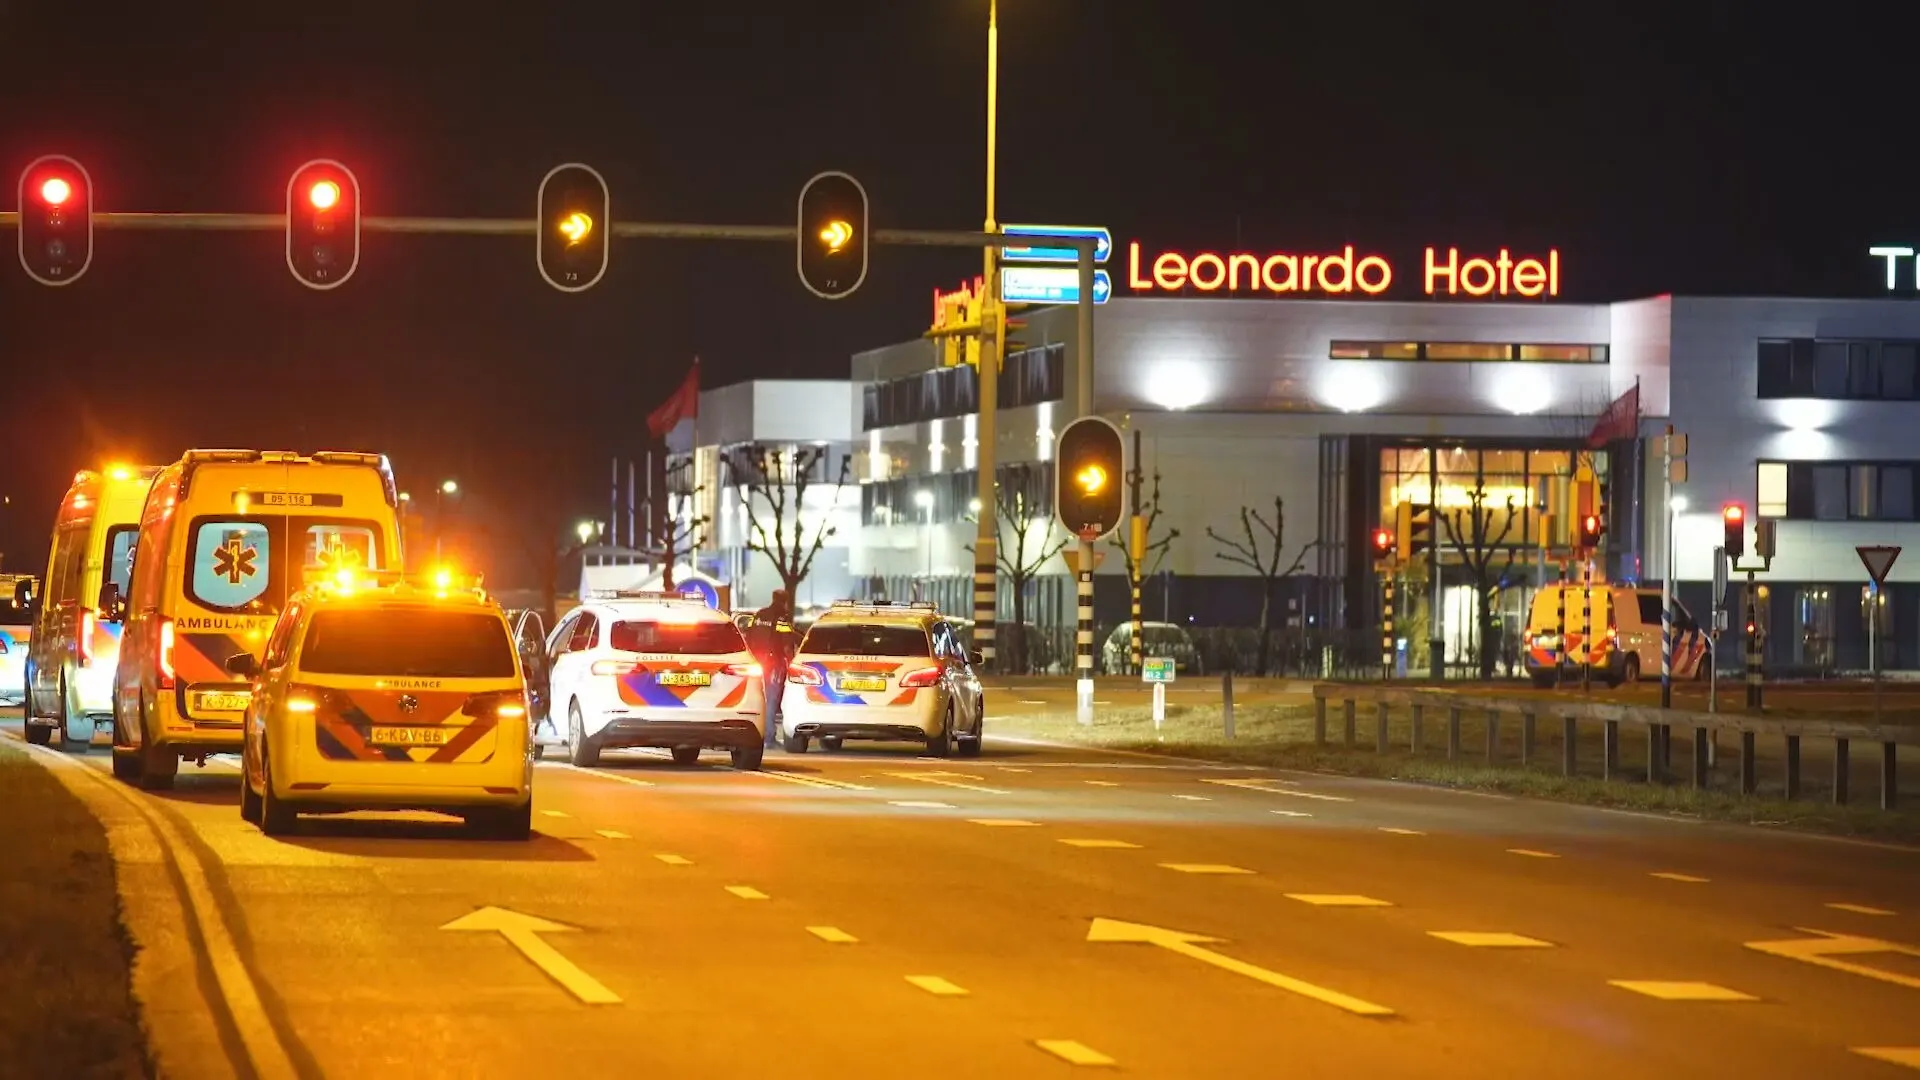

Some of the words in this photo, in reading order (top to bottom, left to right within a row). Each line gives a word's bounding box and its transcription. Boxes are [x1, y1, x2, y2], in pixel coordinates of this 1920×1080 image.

[1129, 242, 1393, 294] Leonardo
[1424, 247, 1560, 297] Hotel
[1869, 247, 1920, 290] T
